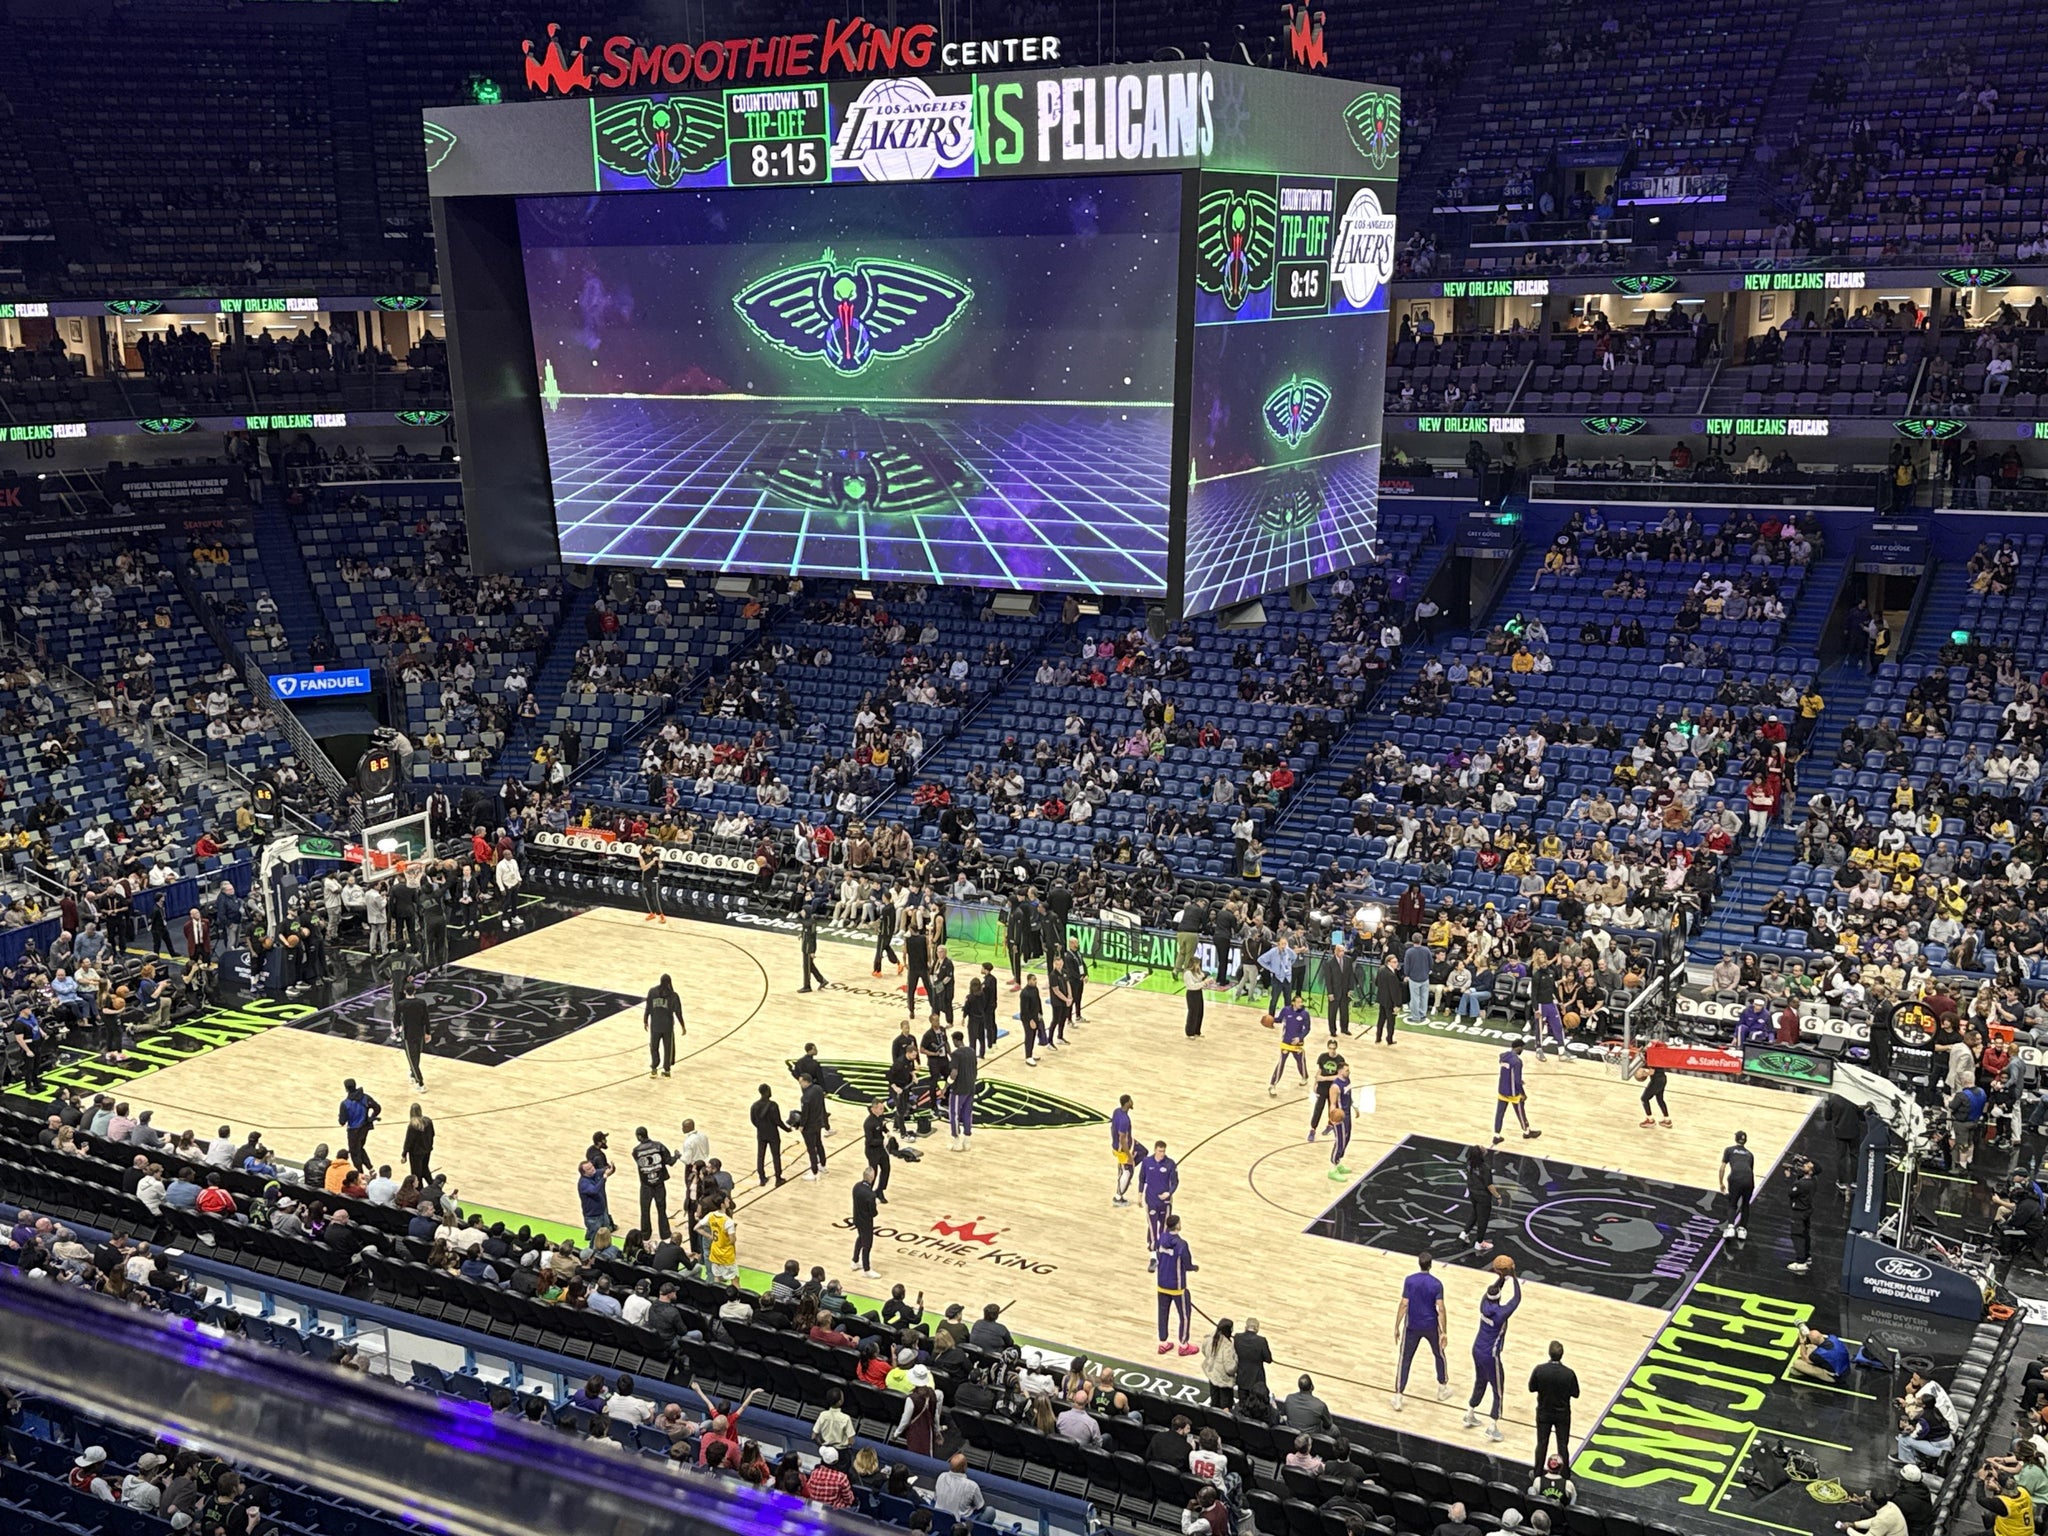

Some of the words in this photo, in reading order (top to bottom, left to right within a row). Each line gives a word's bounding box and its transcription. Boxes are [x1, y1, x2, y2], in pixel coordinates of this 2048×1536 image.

[600, 34, 819, 88] SMOOTHIE
[941, 36, 1060, 66] CENTER
[732, 91, 799, 113] COUNTDOWN
[803, 90, 818, 109] TO
[876, 104, 901, 115] LOS
[903, 101, 967, 114] ANGELES
[1037, 71, 1214, 162] PELICANS
[744, 110, 807, 139] TIP-OFF
[836, 107, 971, 162] LAKERS
[751, 143, 817, 178] 8:15
[1280, 188, 1322, 211] COUNTDOWN
[1323, 190, 1333, 211] TO
[1280, 215, 1330, 257] TIP-OFF
[1333, 220, 1394, 278] LAKERS
[1290, 270, 1320, 298] 8:15
[1744, 273, 1771, 290] NEW
[1773, 272, 1824, 289] ORLEANS
[1825, 271, 1866, 289] PELICANS
[1443, 282, 1467, 297] NEW
[1468, 281, 1513, 296] ORLEANS
[1514, 280, 1549, 296] PELICANS
[220, 299, 242, 312] NEW
[244, 298, 286, 312] ORLEANS
[247, 415, 268, 429] NEW
[271, 414, 313, 429] ORLEANS
[1418, 418, 1442, 432] NEW
[1444, 417, 1489, 433] ORLEANS
[1489, 417, 1525, 433] PELICANS
[1706, 419, 1733, 434] NEW
[1735, 419, 1786, 435] ORLEANS
[1787, 419, 1829, 436] PELICANS
[10, 426, 53, 441] ORLEANS
[122, 482, 151, 491] OFFICIAL
[152, 480, 188, 489] TICKETING
[188, 479, 219, 487] PARTNER
[220, 478, 229, 486] OF
[129, 491, 142, 499] THE
[142, 490, 159, 498] NEW
[159, 488, 190, 497] ORLEANS
[191, 487, 224, 496] PELICANS
[300, 676, 364, 691] FANDUEL
[539, 834, 546, 842] G
[553, 835, 559, 844] G
[567, 837, 574, 846] G
[581, 839, 588, 848] G
[594, 841, 602, 850] G
[610, 843, 617, 852] G
[624, 845, 632, 854] G
[670, 851, 677, 860] G
[686, 853, 693, 862] G
[701, 856, 708, 865] G
[715, 857, 722, 866] G
[731, 860, 739, 868] G
[747, 862, 755, 871] G
[1102, 930, 1180, 967] ORLEAN
[1705, 1004, 1716, 1015] G
[1730, 1007, 1743, 1019] G
[1805, 1018, 1816, 1030] G
[1832, 1022, 1843, 1033] G
[4, 998, 320, 1102] PELICANS
[1902, 1047, 1932, 1058] TISSOT
[2019, 1050, 2034, 1063] G
[897, 1247, 967, 1268] CENTER
[1884, 1259, 1922, 1279] Ford
[1863, 1276, 1907, 1291] SOUTHERN
[1907, 1283, 1942, 1298] QUALITY
[1872, 1285, 1894, 1298] FORD
[1894, 1289, 1931, 1304] DEALERS
[1570, 1283, 1816, 1506] PELICANS
[2023, 1511, 2031, 1526] 6
